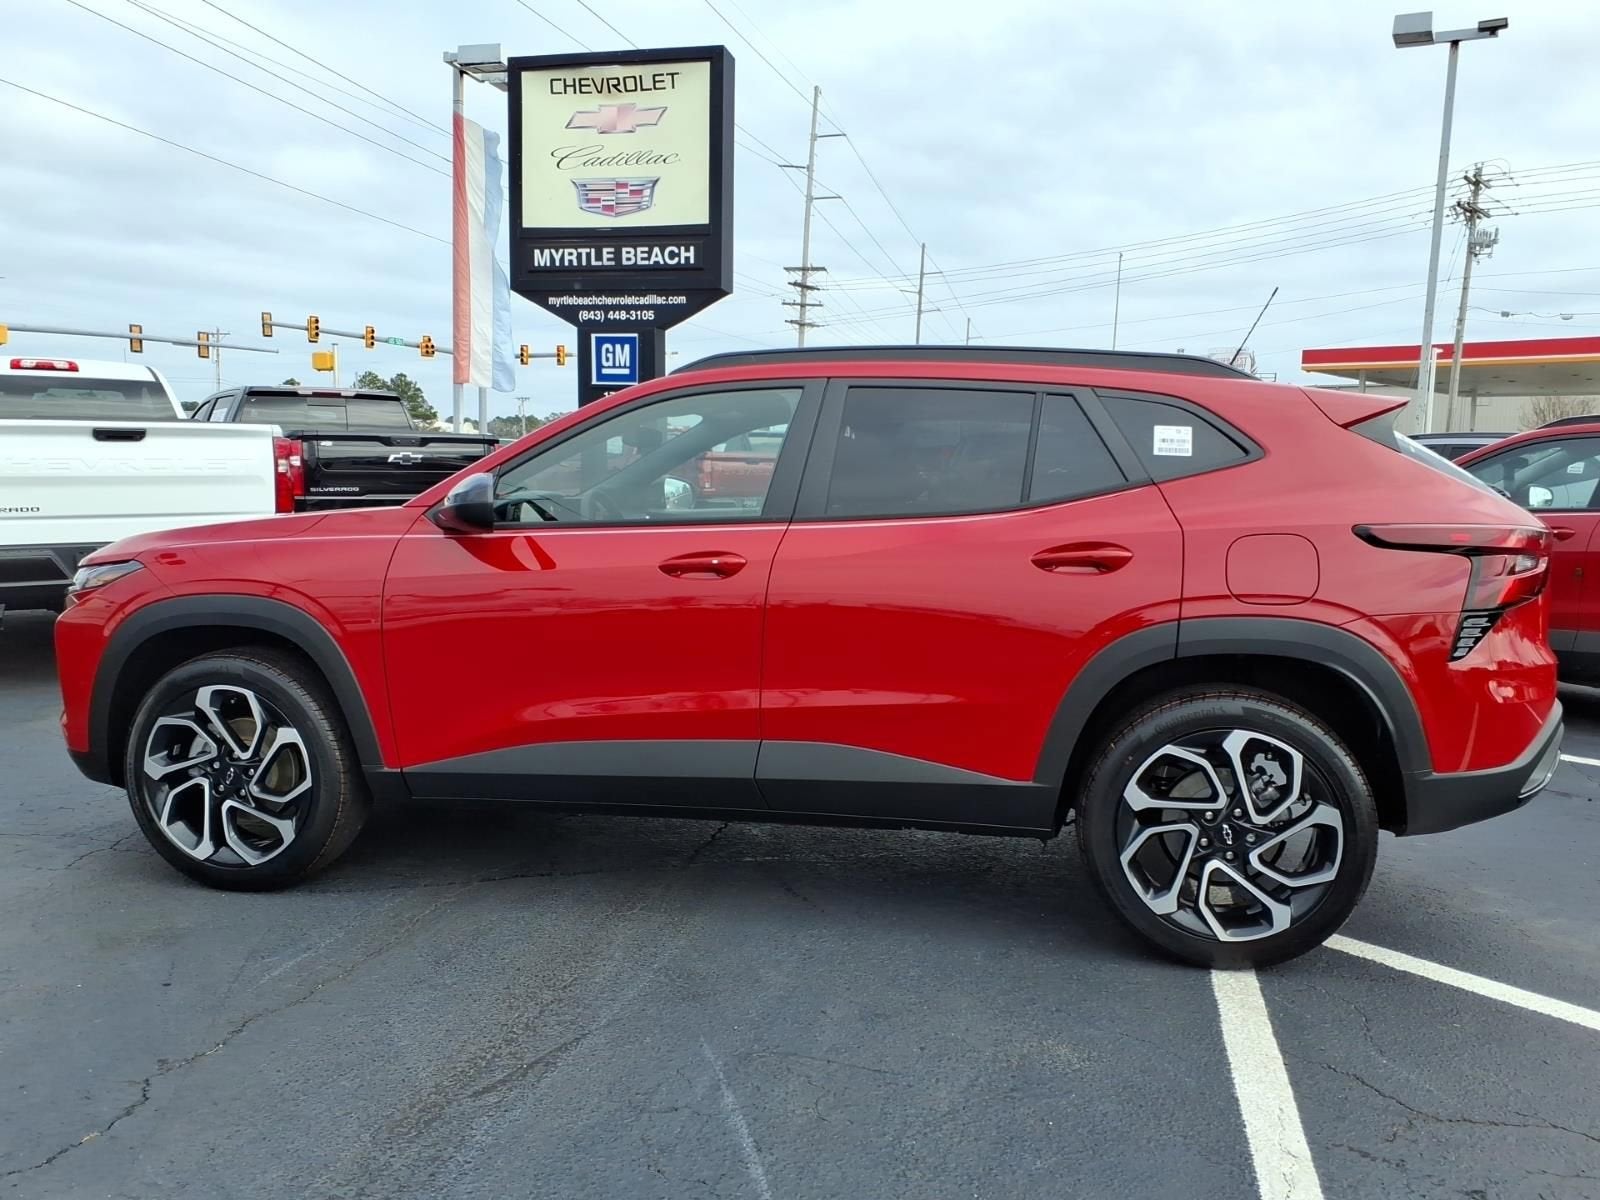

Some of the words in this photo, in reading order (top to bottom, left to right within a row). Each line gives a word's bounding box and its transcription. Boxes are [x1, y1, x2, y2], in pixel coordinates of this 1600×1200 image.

[550, 72, 680, 95] CHEVROLET
[550, 144, 680, 171] Cadillac
[533, 247, 615, 267] MYRTLE
[622, 246, 695, 265] BEACH
[548, 294, 687, 307] myrtlebeachchevroletcadillac.com
[578, 310, 605, 323] (843)
[607, 310, 655, 321] 448-3105
[601, 343, 630, 367] GM
